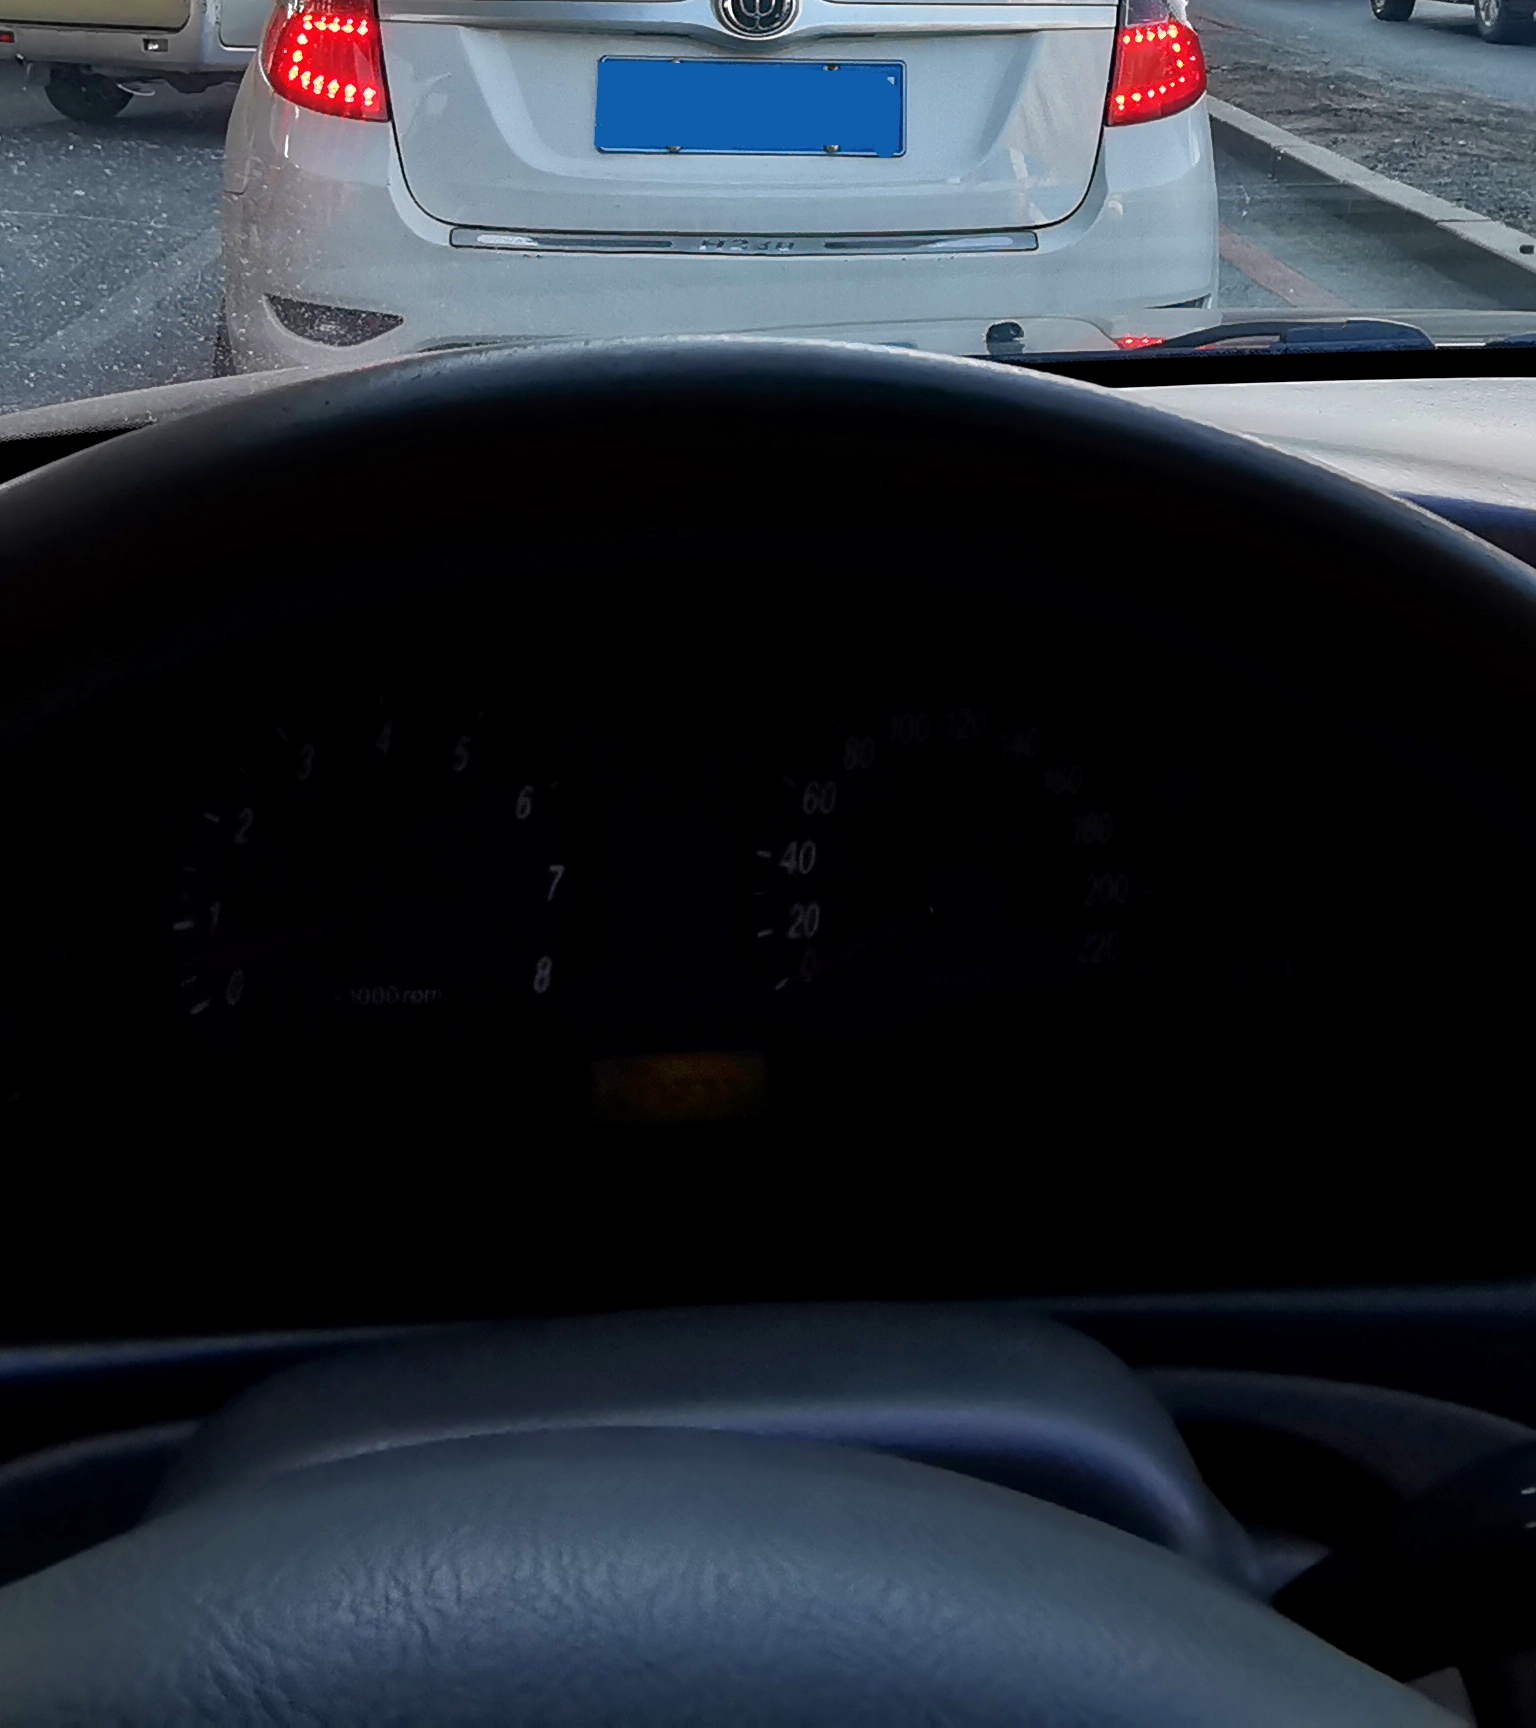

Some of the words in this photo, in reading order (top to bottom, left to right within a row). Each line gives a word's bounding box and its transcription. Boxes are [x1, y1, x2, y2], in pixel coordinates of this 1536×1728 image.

[514, 783, 536, 823] 6
[801, 779, 839, 816] 60
[232, 806, 255, 845] 2
[777, 837, 817, 875] 40
[543, 863, 566, 903] 7
[785, 900, 822, 940] 20
[532, 954, 554, 995] 8
